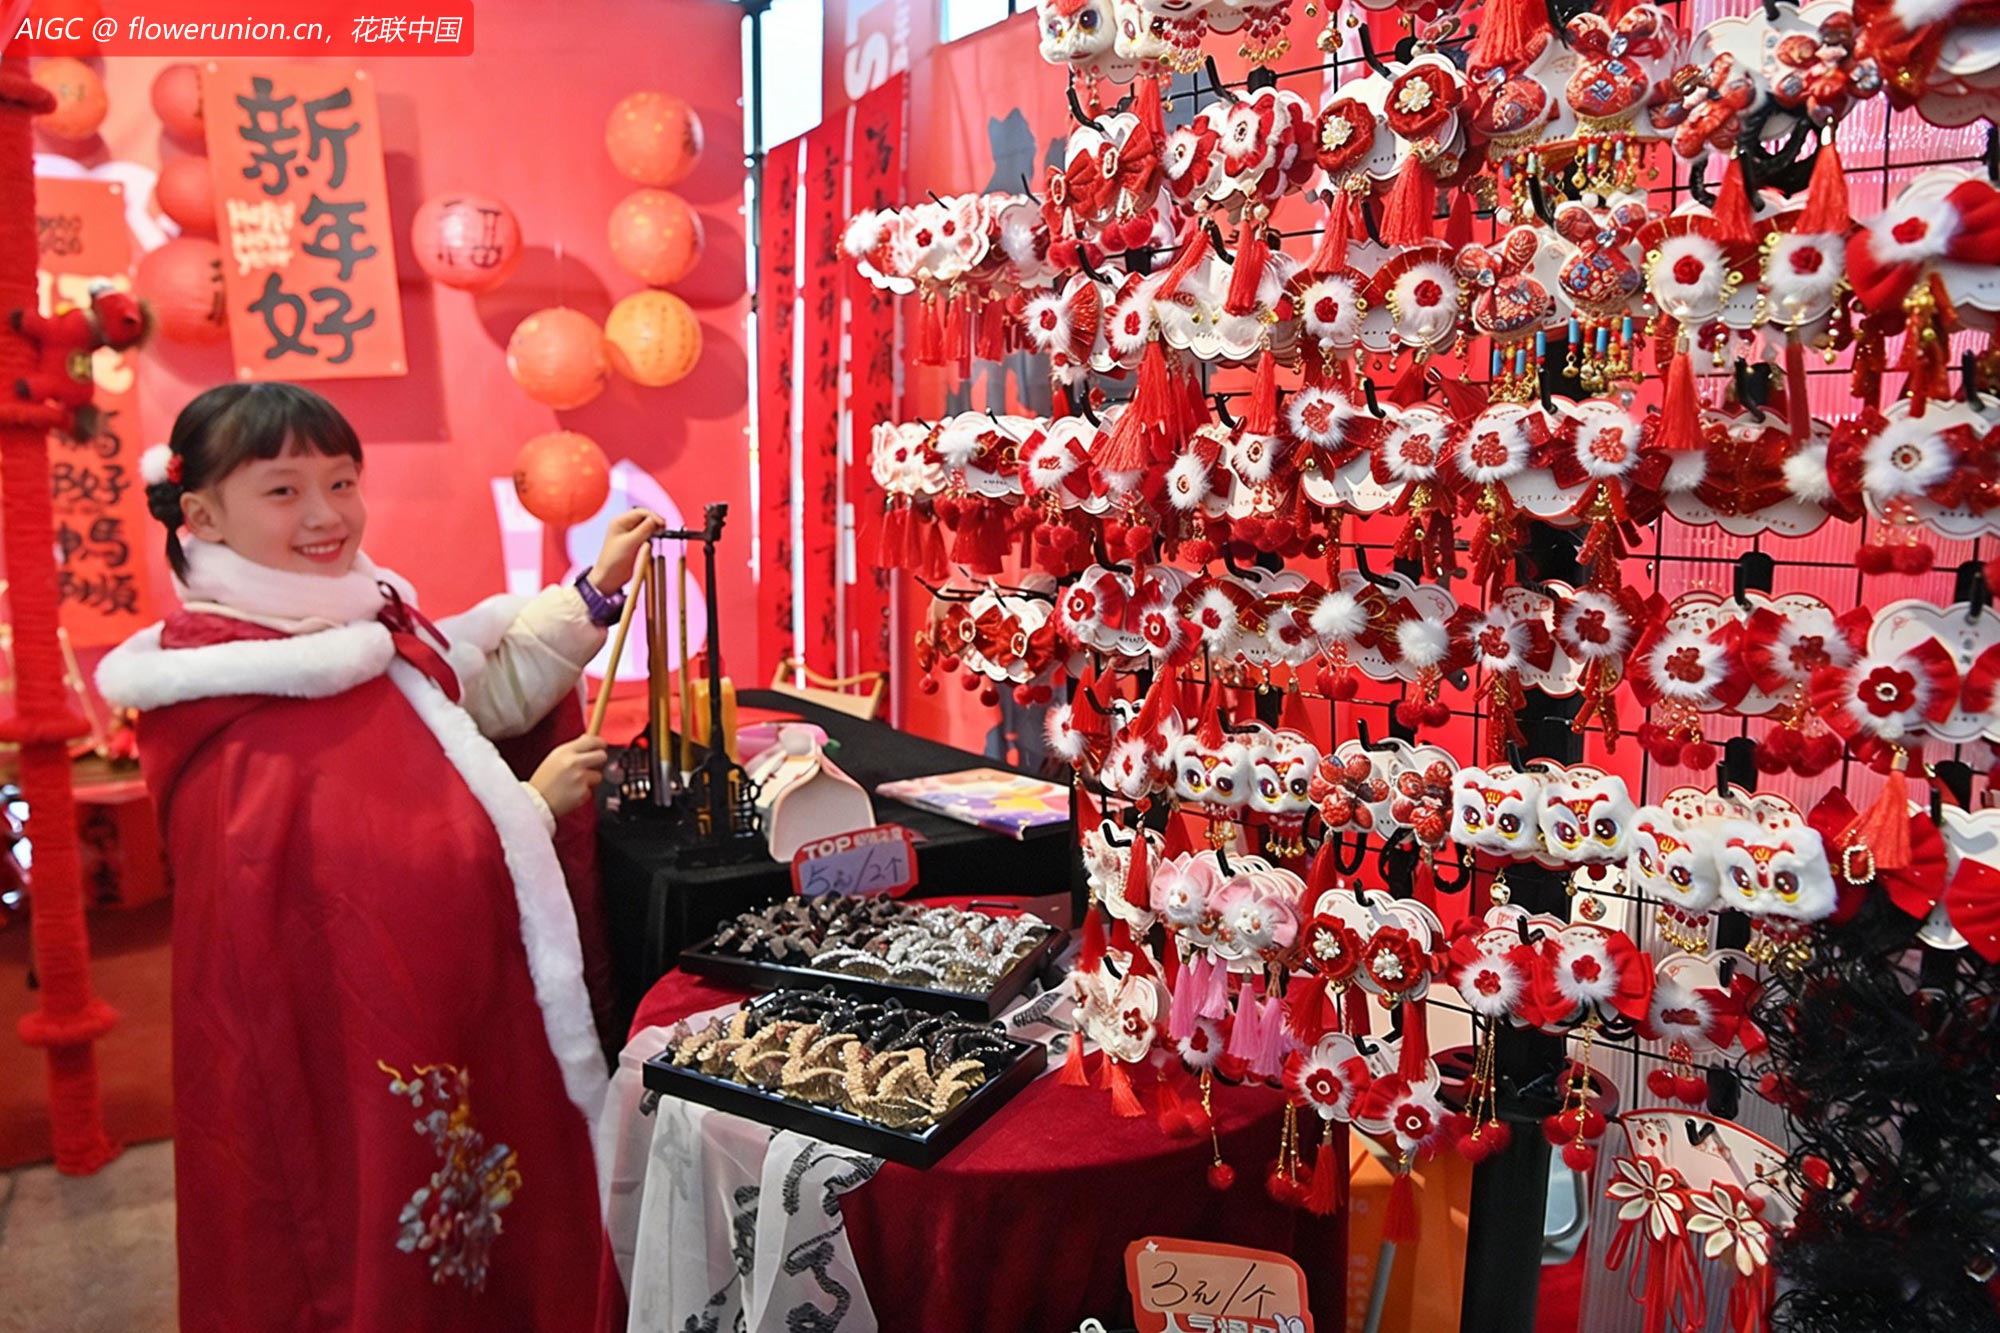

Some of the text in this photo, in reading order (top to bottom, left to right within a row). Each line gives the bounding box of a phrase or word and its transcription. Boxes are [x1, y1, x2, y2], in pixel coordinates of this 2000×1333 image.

[236, 76, 377, 364] 新年好
[802, 836, 851, 860] TOP
[1151, 1260, 1276, 1319] 3元/个
